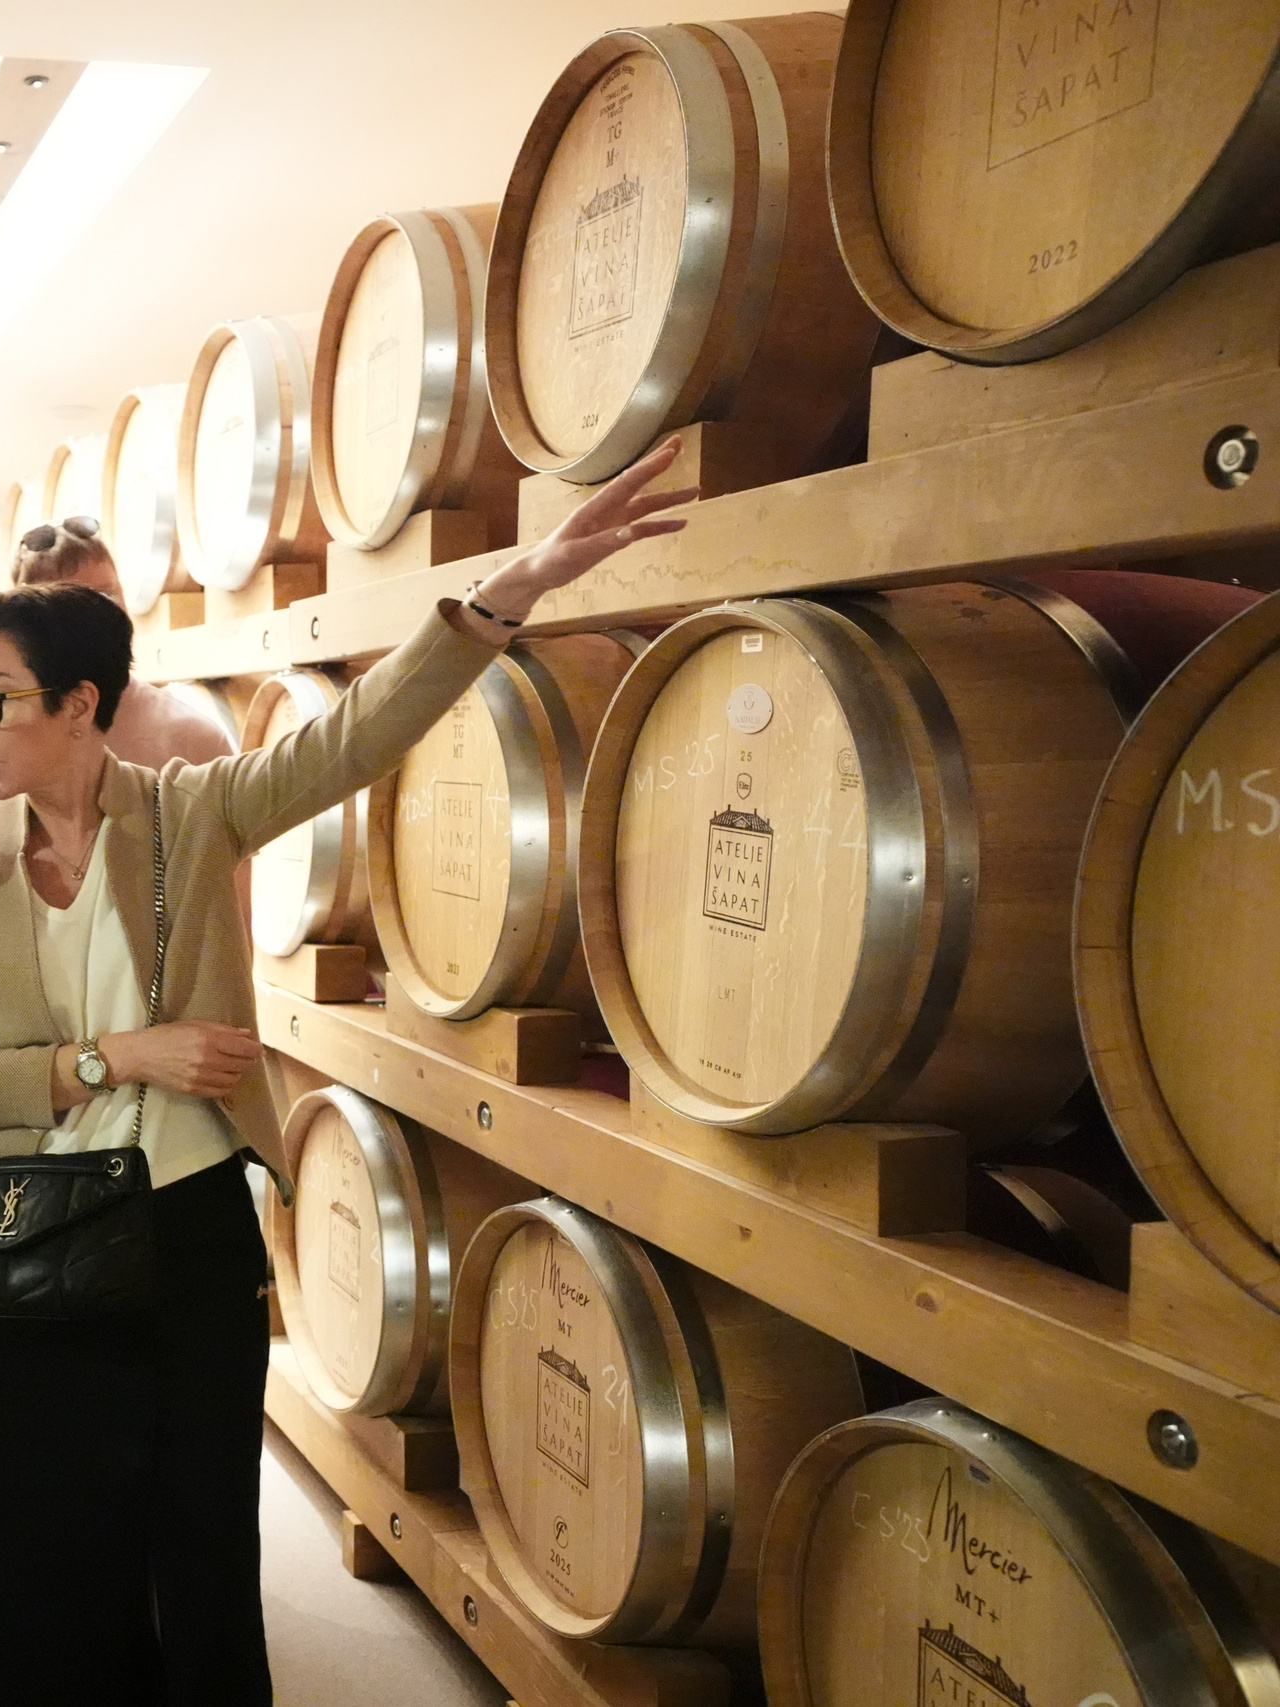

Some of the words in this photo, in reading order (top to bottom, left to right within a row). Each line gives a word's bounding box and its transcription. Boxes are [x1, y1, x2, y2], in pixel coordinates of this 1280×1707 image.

[1012, 46, 1130, 128] ŠAPAT
[582, 252, 629, 287] VINA
[1028, 240, 1079, 274] 2022
[578, 284, 627, 321] ŠAPAT
[740, 750, 752, 761] 25
[440, 829, 473, 850] VINA
[715, 840, 763, 863] ATELJE
[440, 855, 473, 881] ŠAPAT
[714, 865, 760, 888] VINA
[711, 886, 759, 914] ŠAPAT
[709, 924, 727, 935] WINE
[730, 930, 757, 943] ESTATE
[541, 1237, 590, 1309] Mercier
[558, 1318, 573, 1338] MT
[543, 1377, 583, 1417] ATELJE
[544, 1401, 583, 1443] VINA
[543, 1423, 582, 1468] ŠAPAT
[926, 1466, 1032, 1585] Mercier
[550, 1549, 571, 1576] 2025
